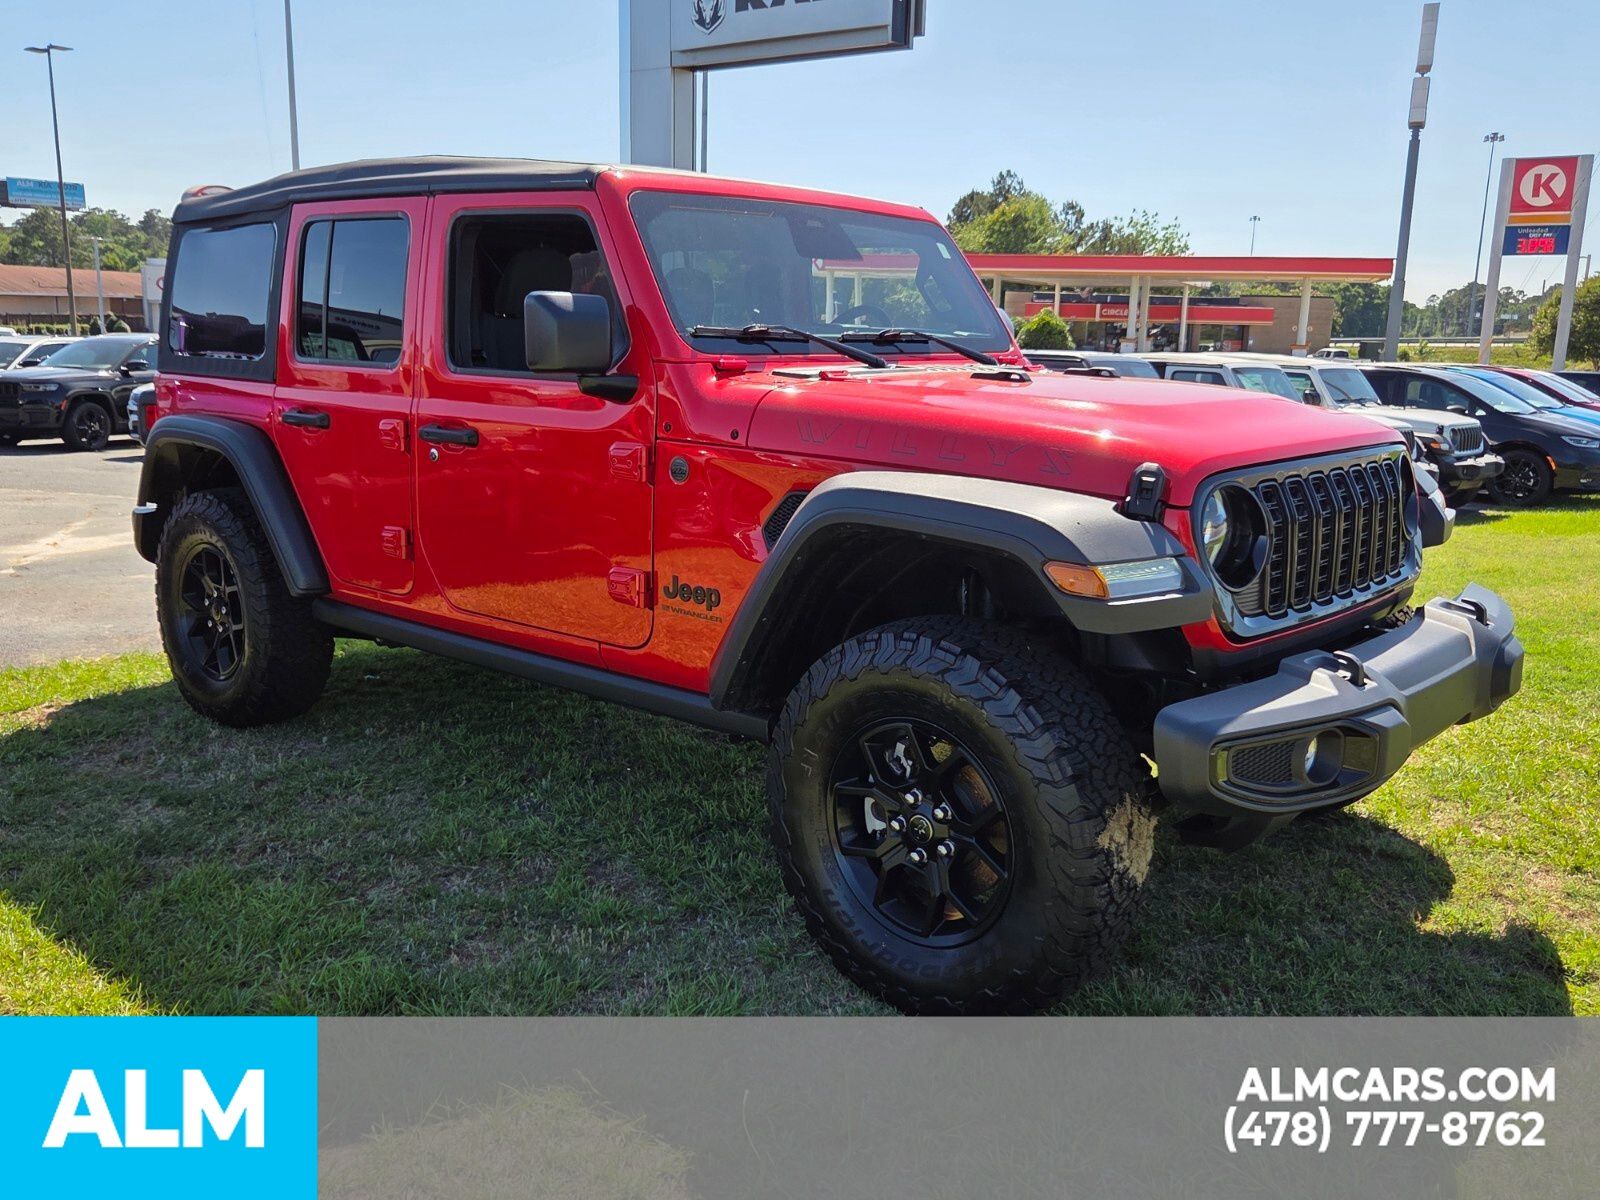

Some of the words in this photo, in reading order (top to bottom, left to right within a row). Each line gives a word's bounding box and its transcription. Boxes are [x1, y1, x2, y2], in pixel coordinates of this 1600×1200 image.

[1101, 308, 1129, 316] CIRCLE
[796, 417, 1074, 476] WILLYS
[663, 574, 721, 612] Jeep
[670, 606, 723, 624] WRANGLER
